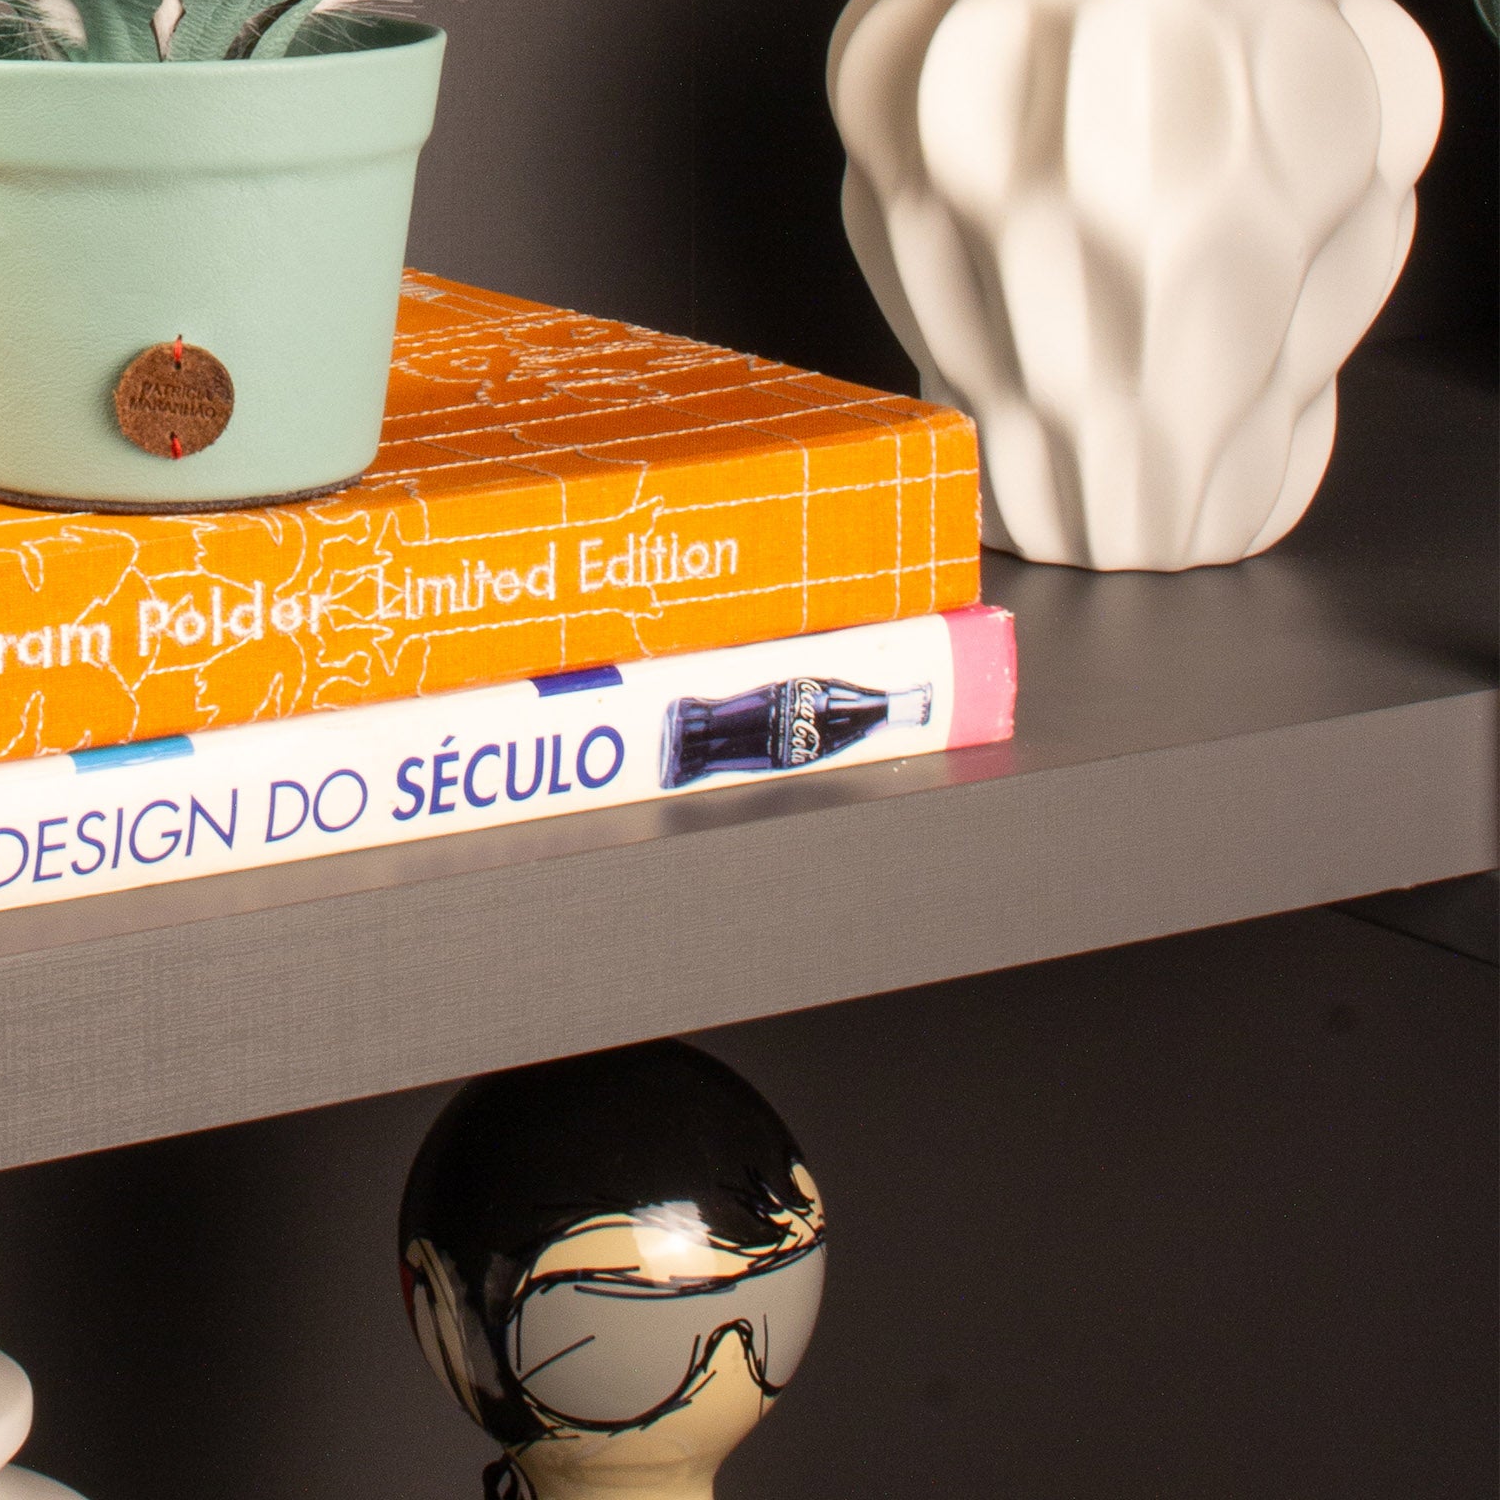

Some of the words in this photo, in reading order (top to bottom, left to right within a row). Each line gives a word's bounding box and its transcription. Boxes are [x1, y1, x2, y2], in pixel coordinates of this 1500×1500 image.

[137, 578, 334, 658] Polder
[375, 540, 558, 622] Limited
[579, 530, 740, 594] Edition
[264, 768, 370, 844] DO
[391, 724, 626, 821] SÉCULO
